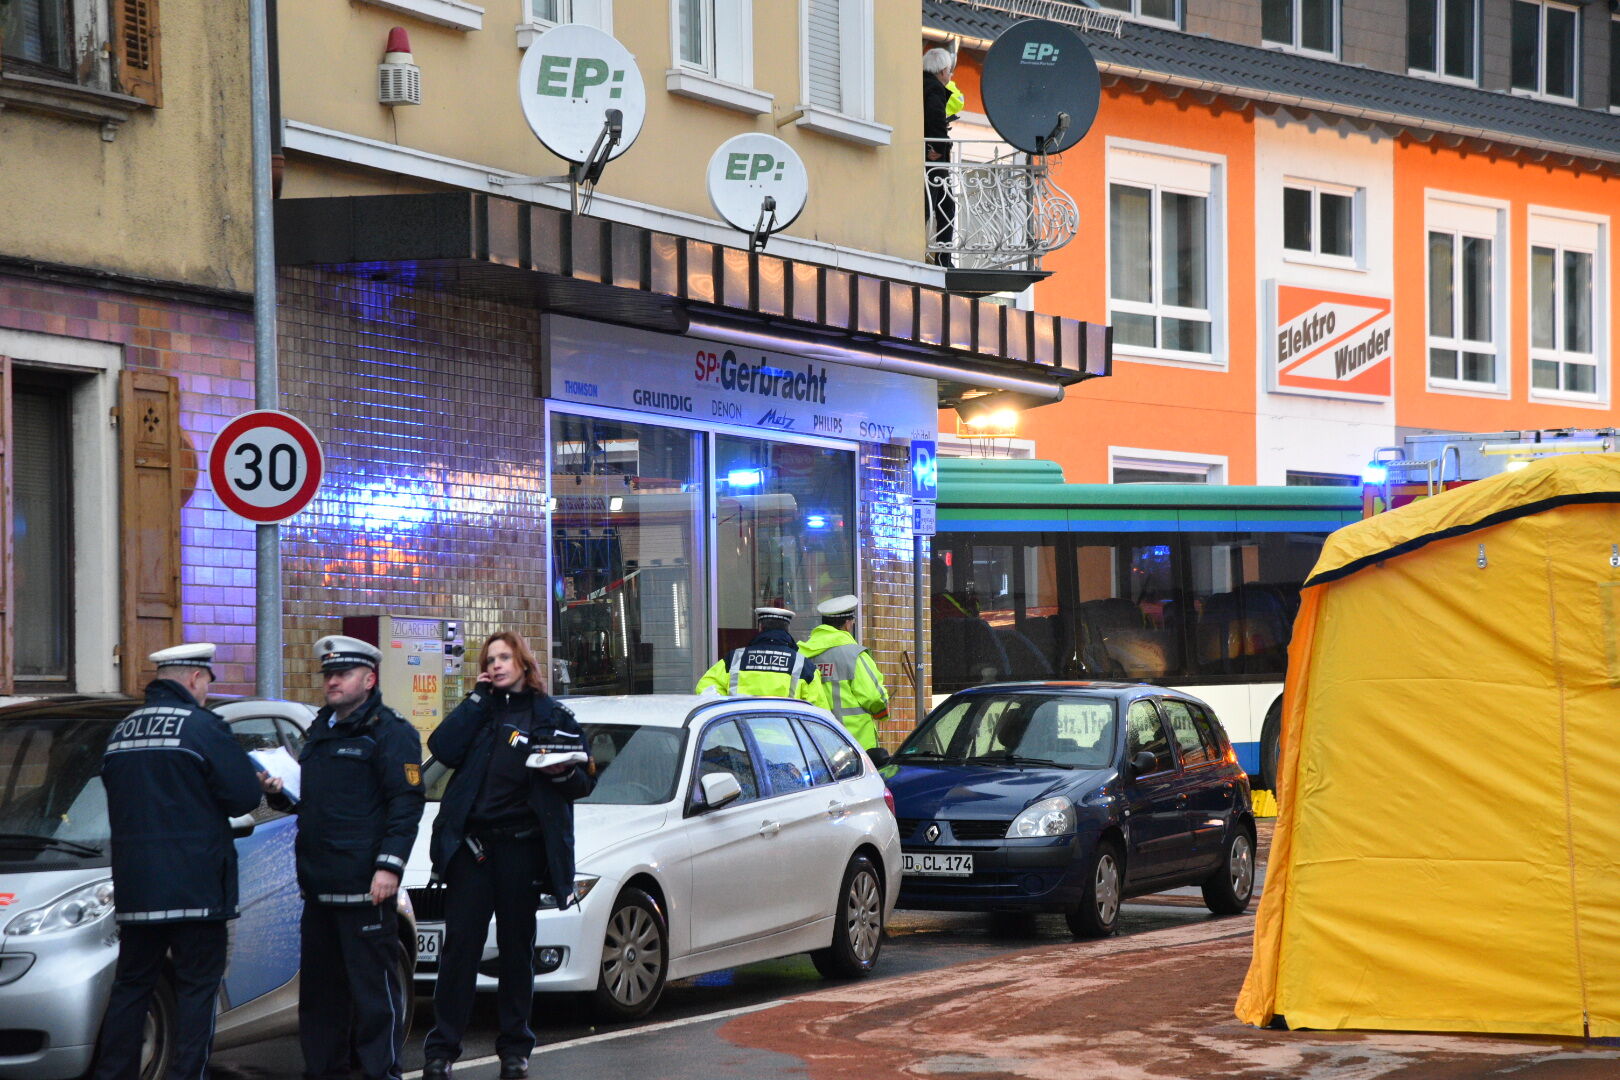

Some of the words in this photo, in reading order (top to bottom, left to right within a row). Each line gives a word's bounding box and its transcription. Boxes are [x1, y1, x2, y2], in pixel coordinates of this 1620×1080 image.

[1021, 42, 1060, 61] EP:
[536, 54, 625, 98] EP:
[725, 153, 785, 181] EP:
[1278, 310, 1336, 364] Elektro
[1334, 327, 1391, 380] Wunder
[564, 380, 598, 398] THOMSON
[632, 388, 693, 413] GRUNDIG
[711, 399, 742, 419] DENON
[756, 407, 796, 431] Metz
[813, 414, 843, 434] PHILIPS
[860, 420, 895, 440] SONY
[233, 442, 298, 492] 30
[394, 622, 441, 637] ZIGARETTEN
[747, 654, 790, 668] POLIZEI
[412, 674, 438, 694] ALLES
[112, 715, 185, 740] POLIZEI
[923, 856, 942, 870] CL
[945, 856, 972, 871] 174
